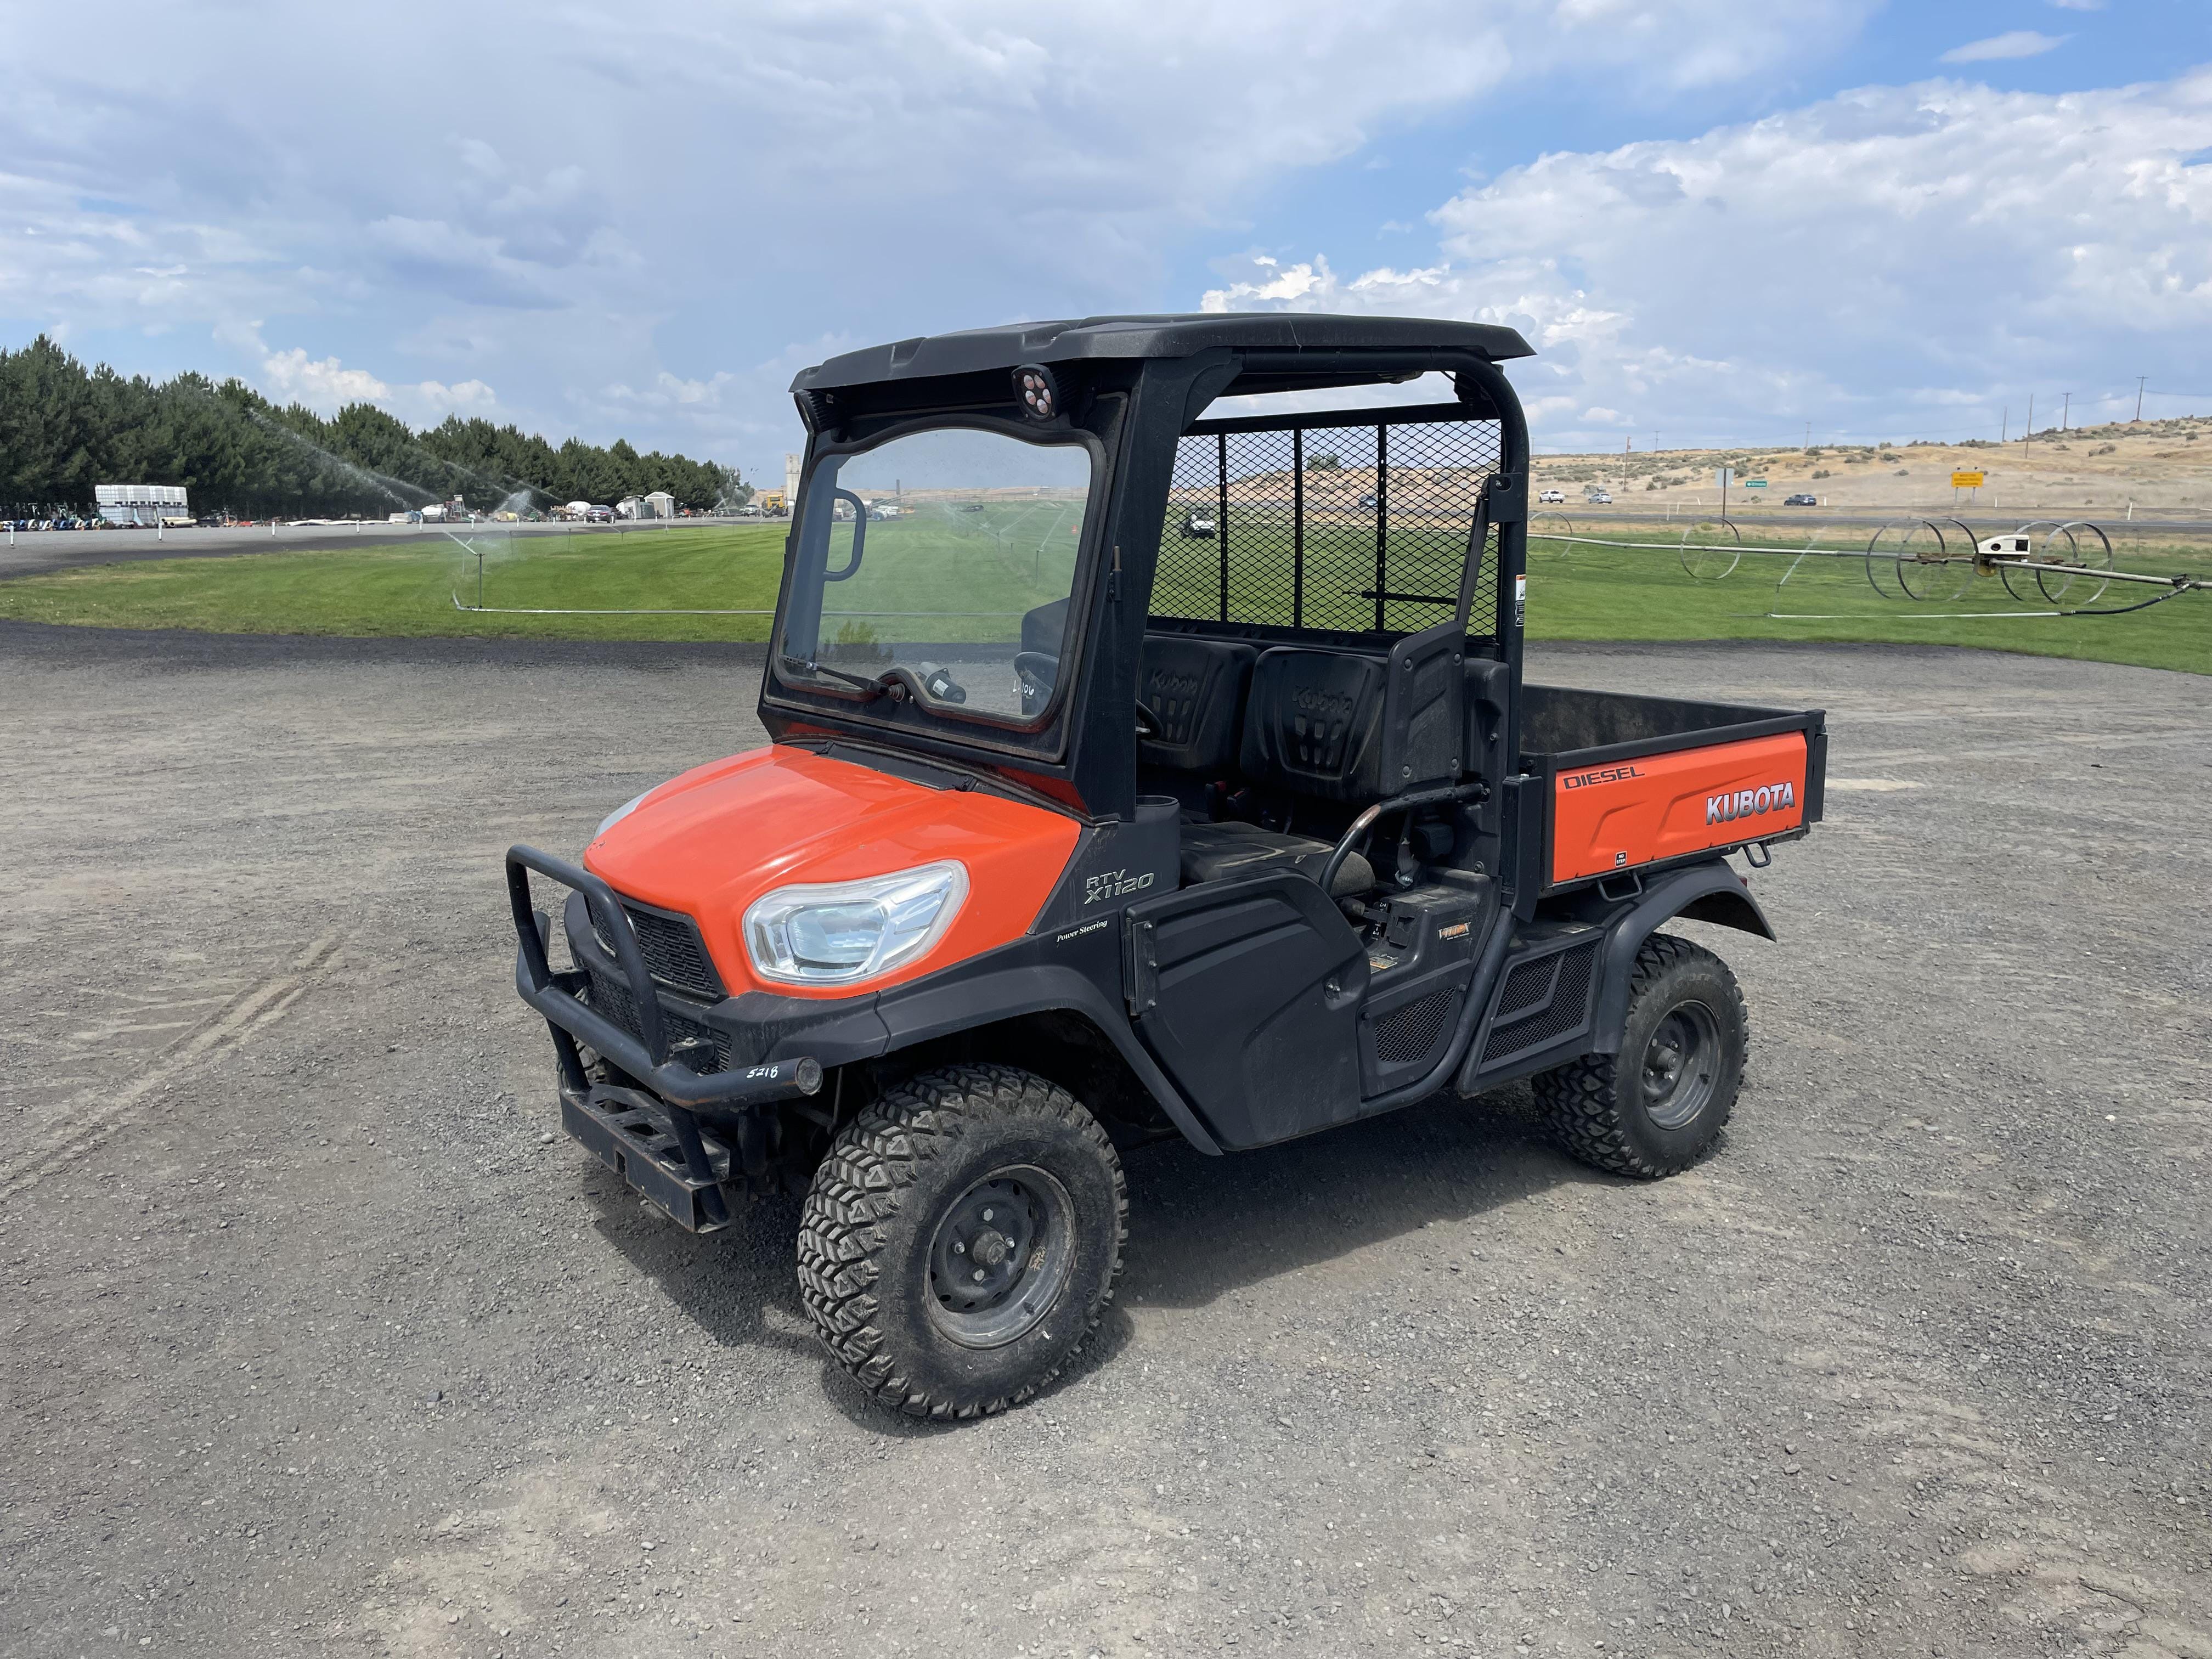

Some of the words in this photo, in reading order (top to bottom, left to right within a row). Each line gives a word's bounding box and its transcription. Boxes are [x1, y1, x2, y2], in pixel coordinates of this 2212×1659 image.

[1563, 766, 1645, 789] DIESEL
[1706, 781, 1795, 826] KUBOTA
[1084, 873, 1155, 905] X1120
[1086, 868, 1126, 889] RTV
[1056, 929, 1079, 943] Power
[1079, 919, 1108, 935] Steering
[746, 1065, 778, 1079] 5218
